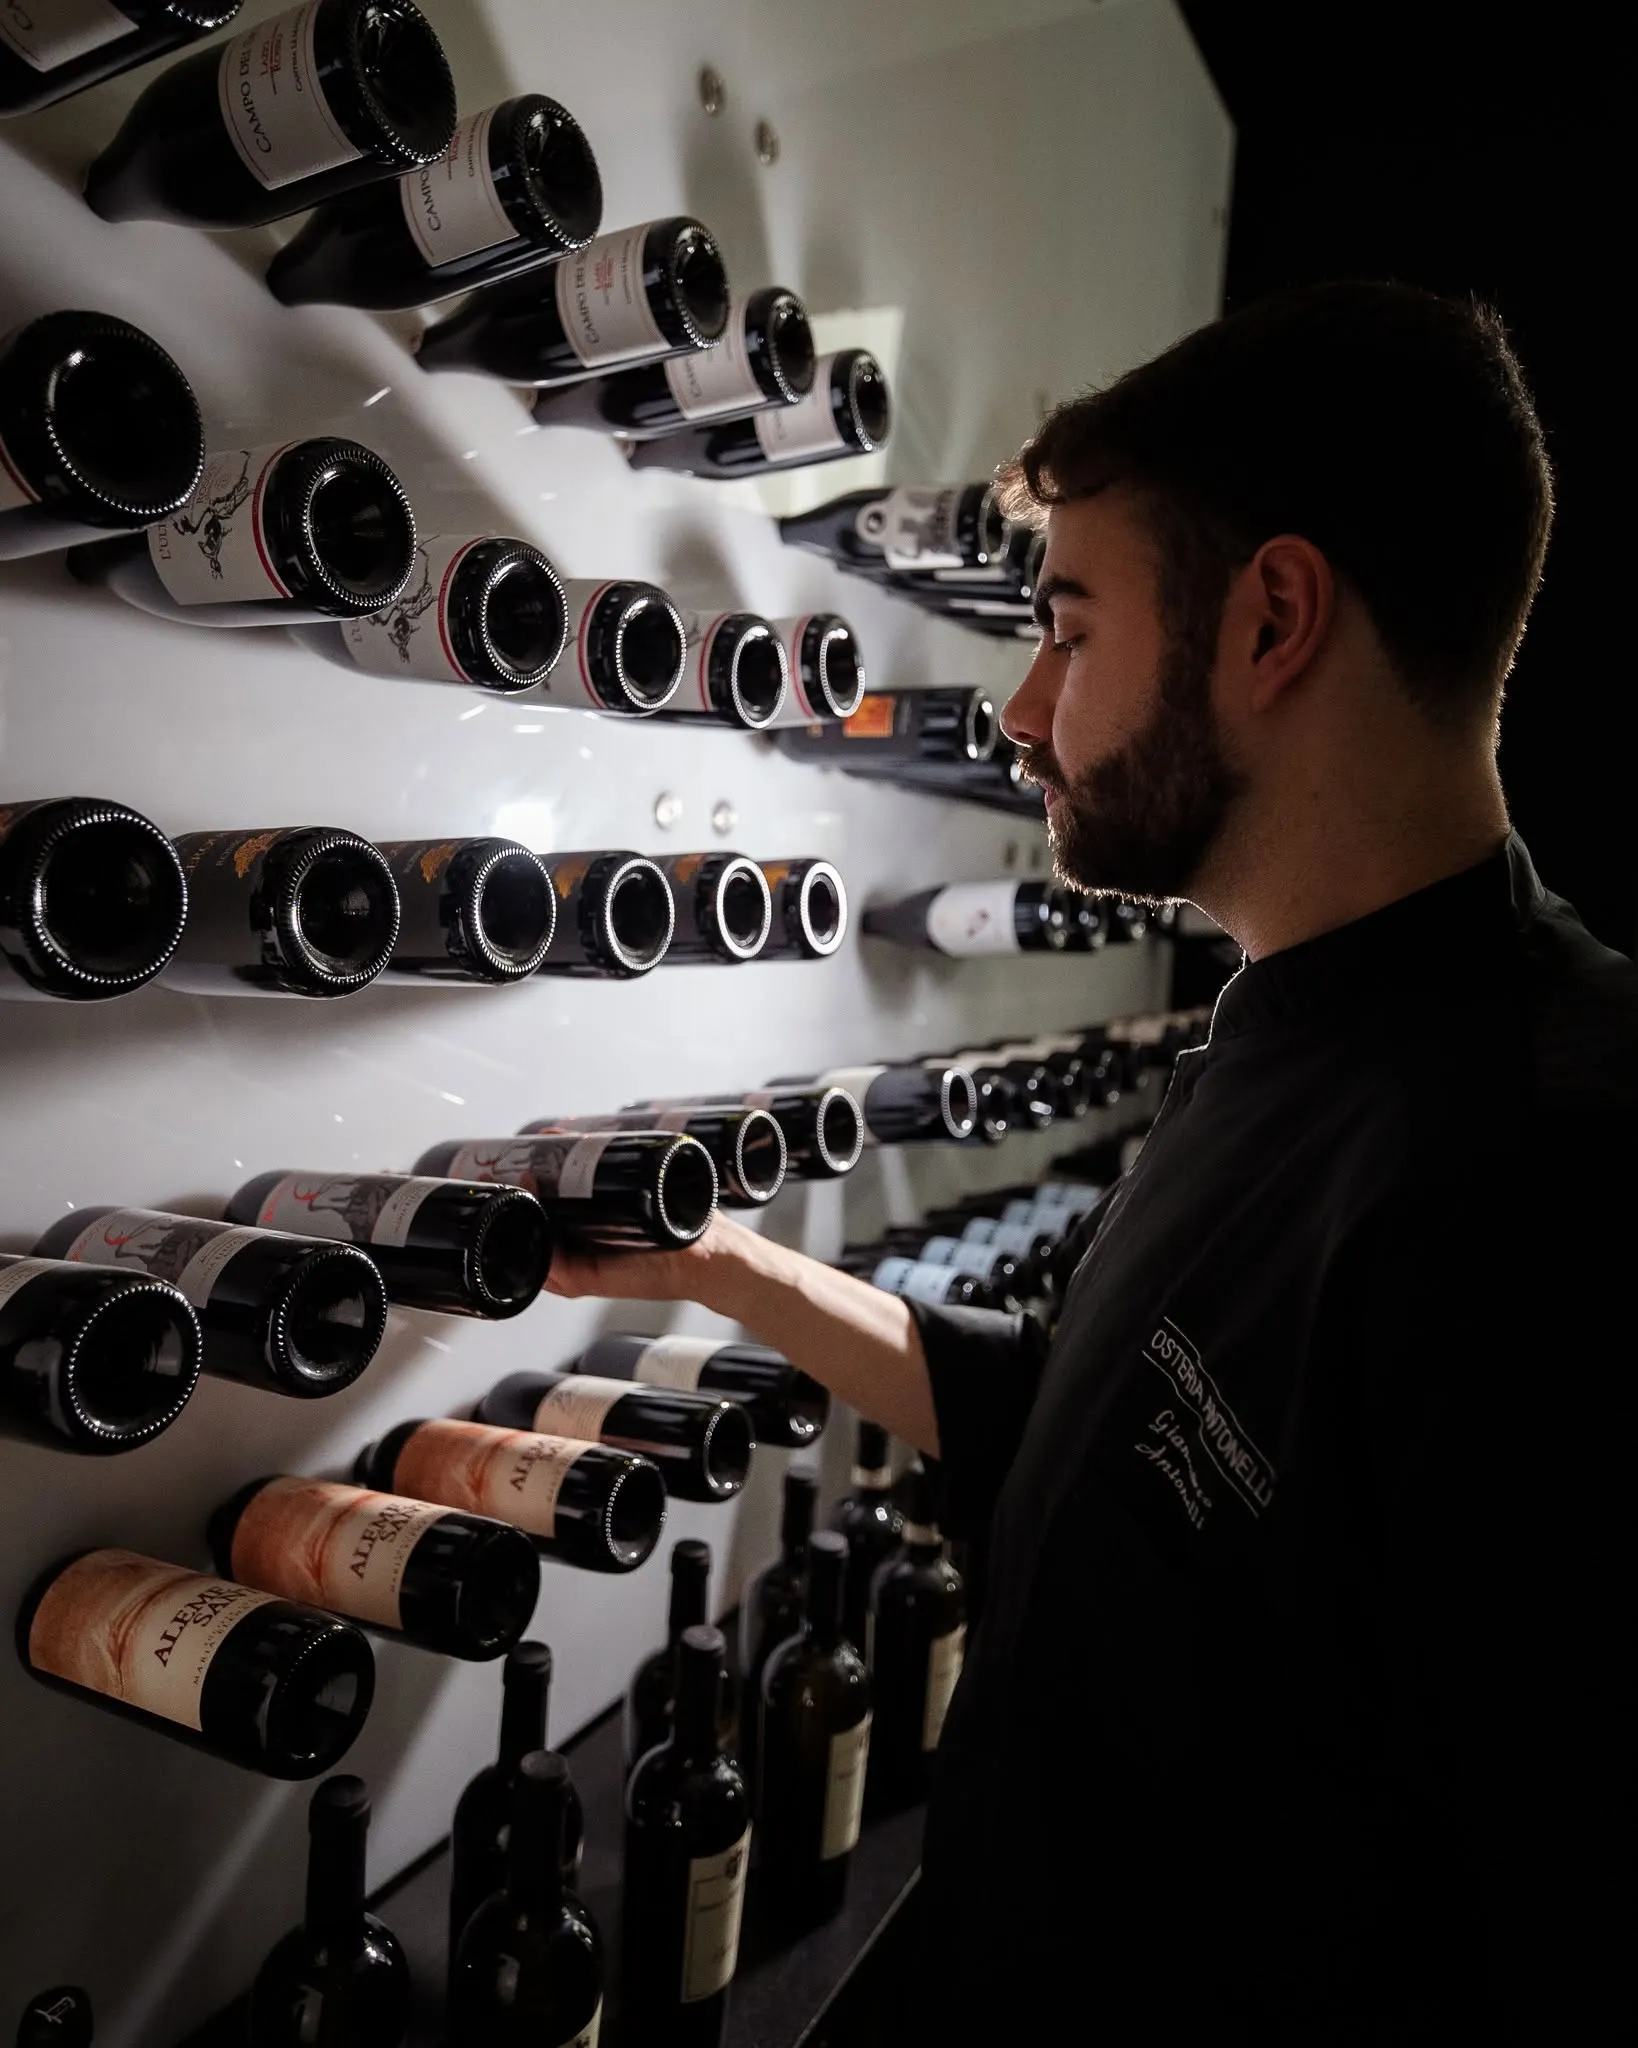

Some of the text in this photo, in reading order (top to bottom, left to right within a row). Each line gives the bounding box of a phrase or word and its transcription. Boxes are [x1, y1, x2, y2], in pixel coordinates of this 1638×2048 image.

[240, 81, 272, 153] CAMPO
[418, 170, 441, 231] CAMPO
[1151, 1329, 1275, 1509] OSTERIA ANTONELLI
